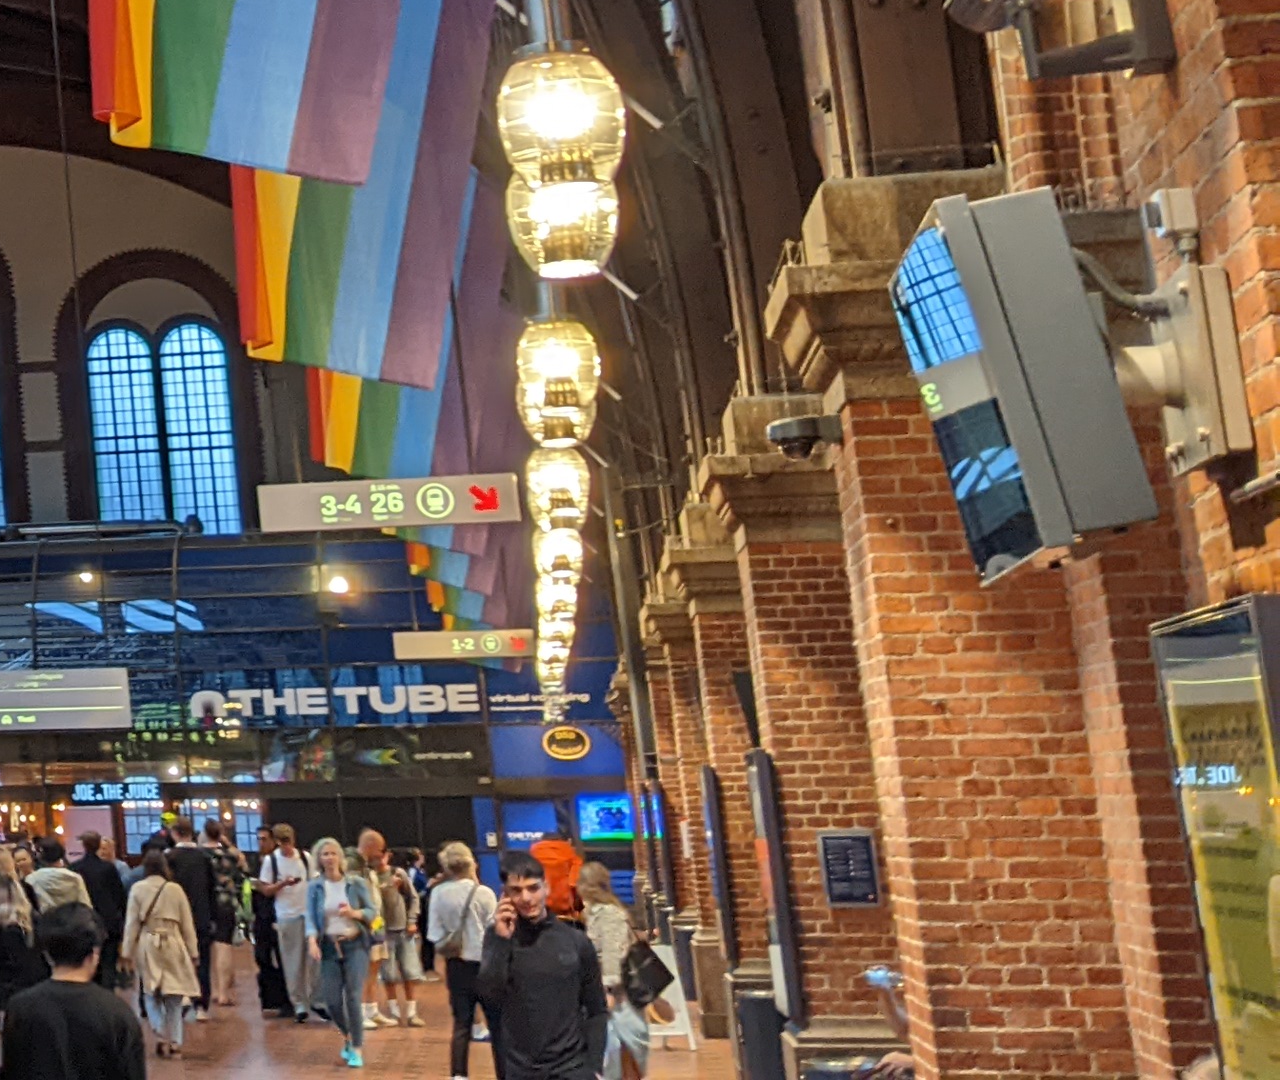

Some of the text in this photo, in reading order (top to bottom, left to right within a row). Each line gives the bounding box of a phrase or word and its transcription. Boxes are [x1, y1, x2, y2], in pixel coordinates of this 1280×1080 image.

[320, 492, 404, 516] 3-4 26
[451, 638, 475, 650] 1-2
[228, 684, 480, 717] THE TUBE
[71, 783, 95, 801] JOE
[101, 783, 124, 800] THE
[125, 783, 160, 799] JUICE
